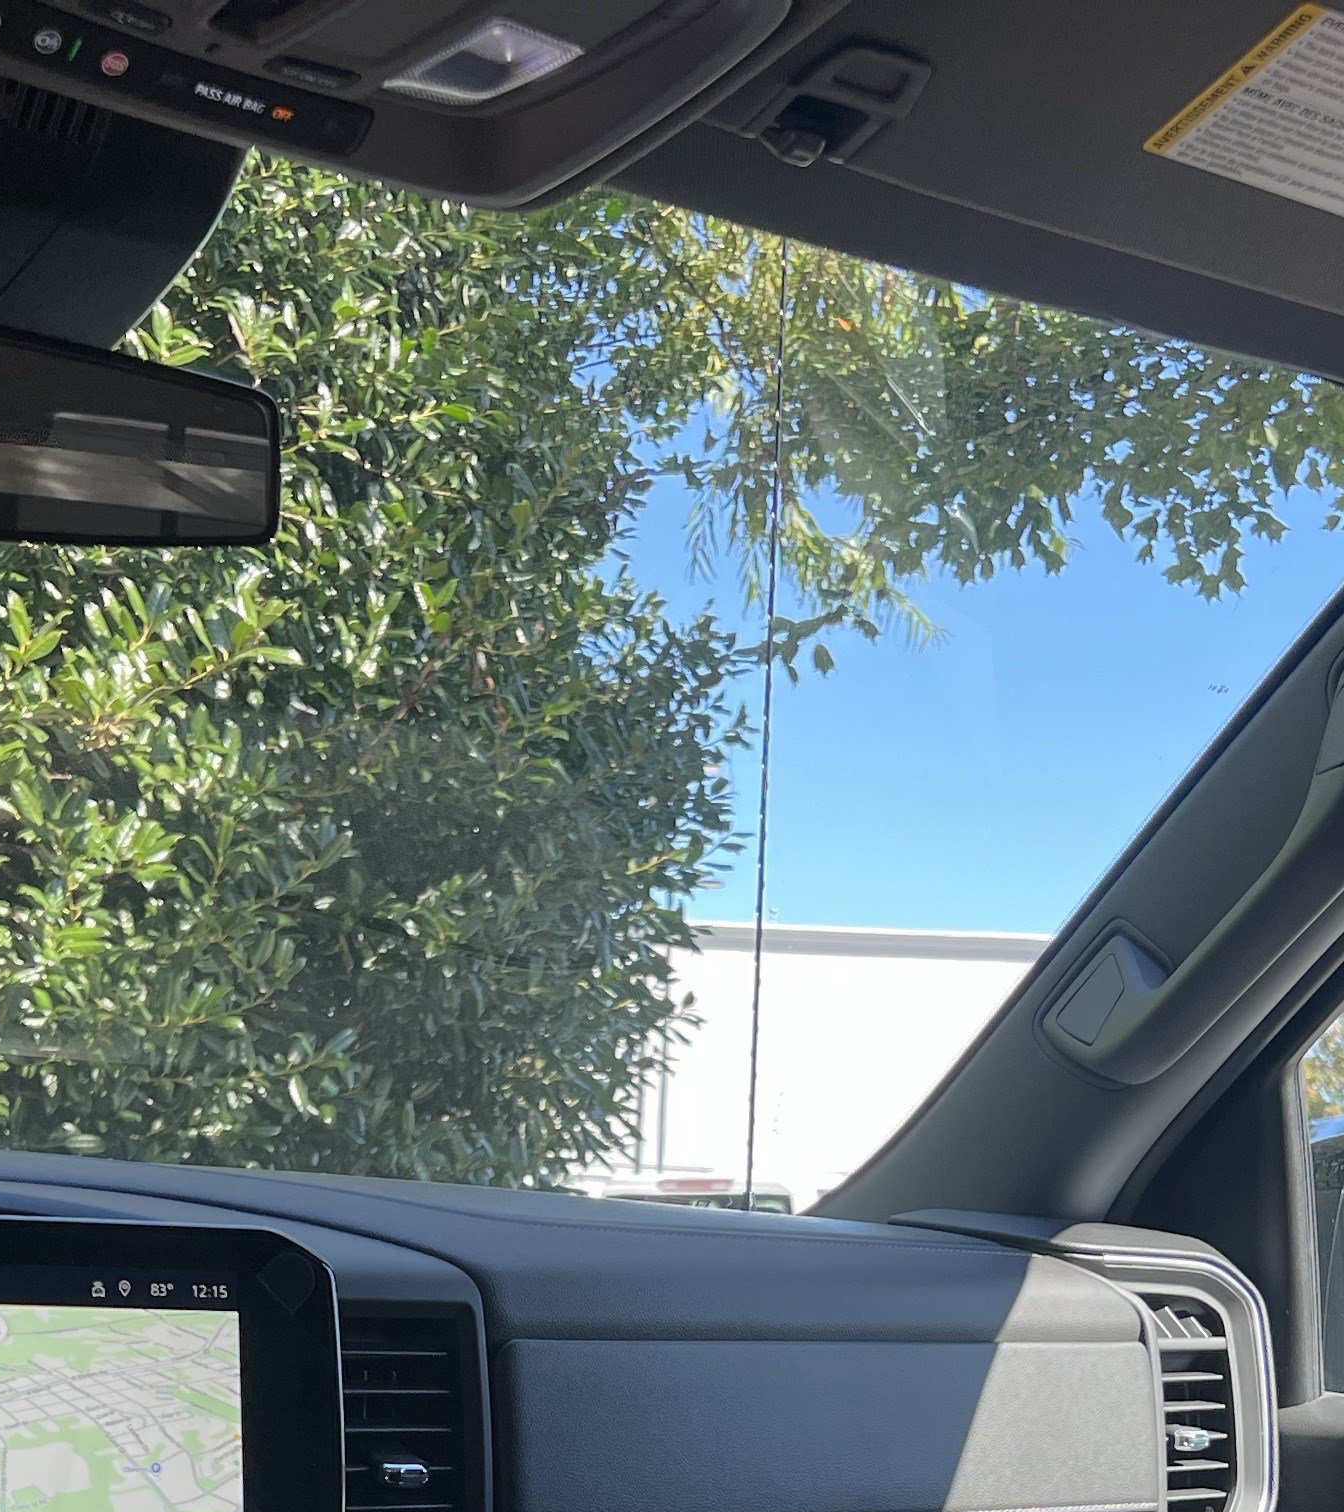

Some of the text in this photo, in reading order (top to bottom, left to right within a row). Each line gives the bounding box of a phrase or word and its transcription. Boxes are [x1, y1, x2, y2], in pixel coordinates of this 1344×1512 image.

[1257, 13, 1313, 61] WARNING
[193, 82, 295, 122] PASS AIR BAG OFF
[1153, 75, 1238, 150] AVERTISSEMENT
[150, 1282, 229, 1299] 83° 12:15
